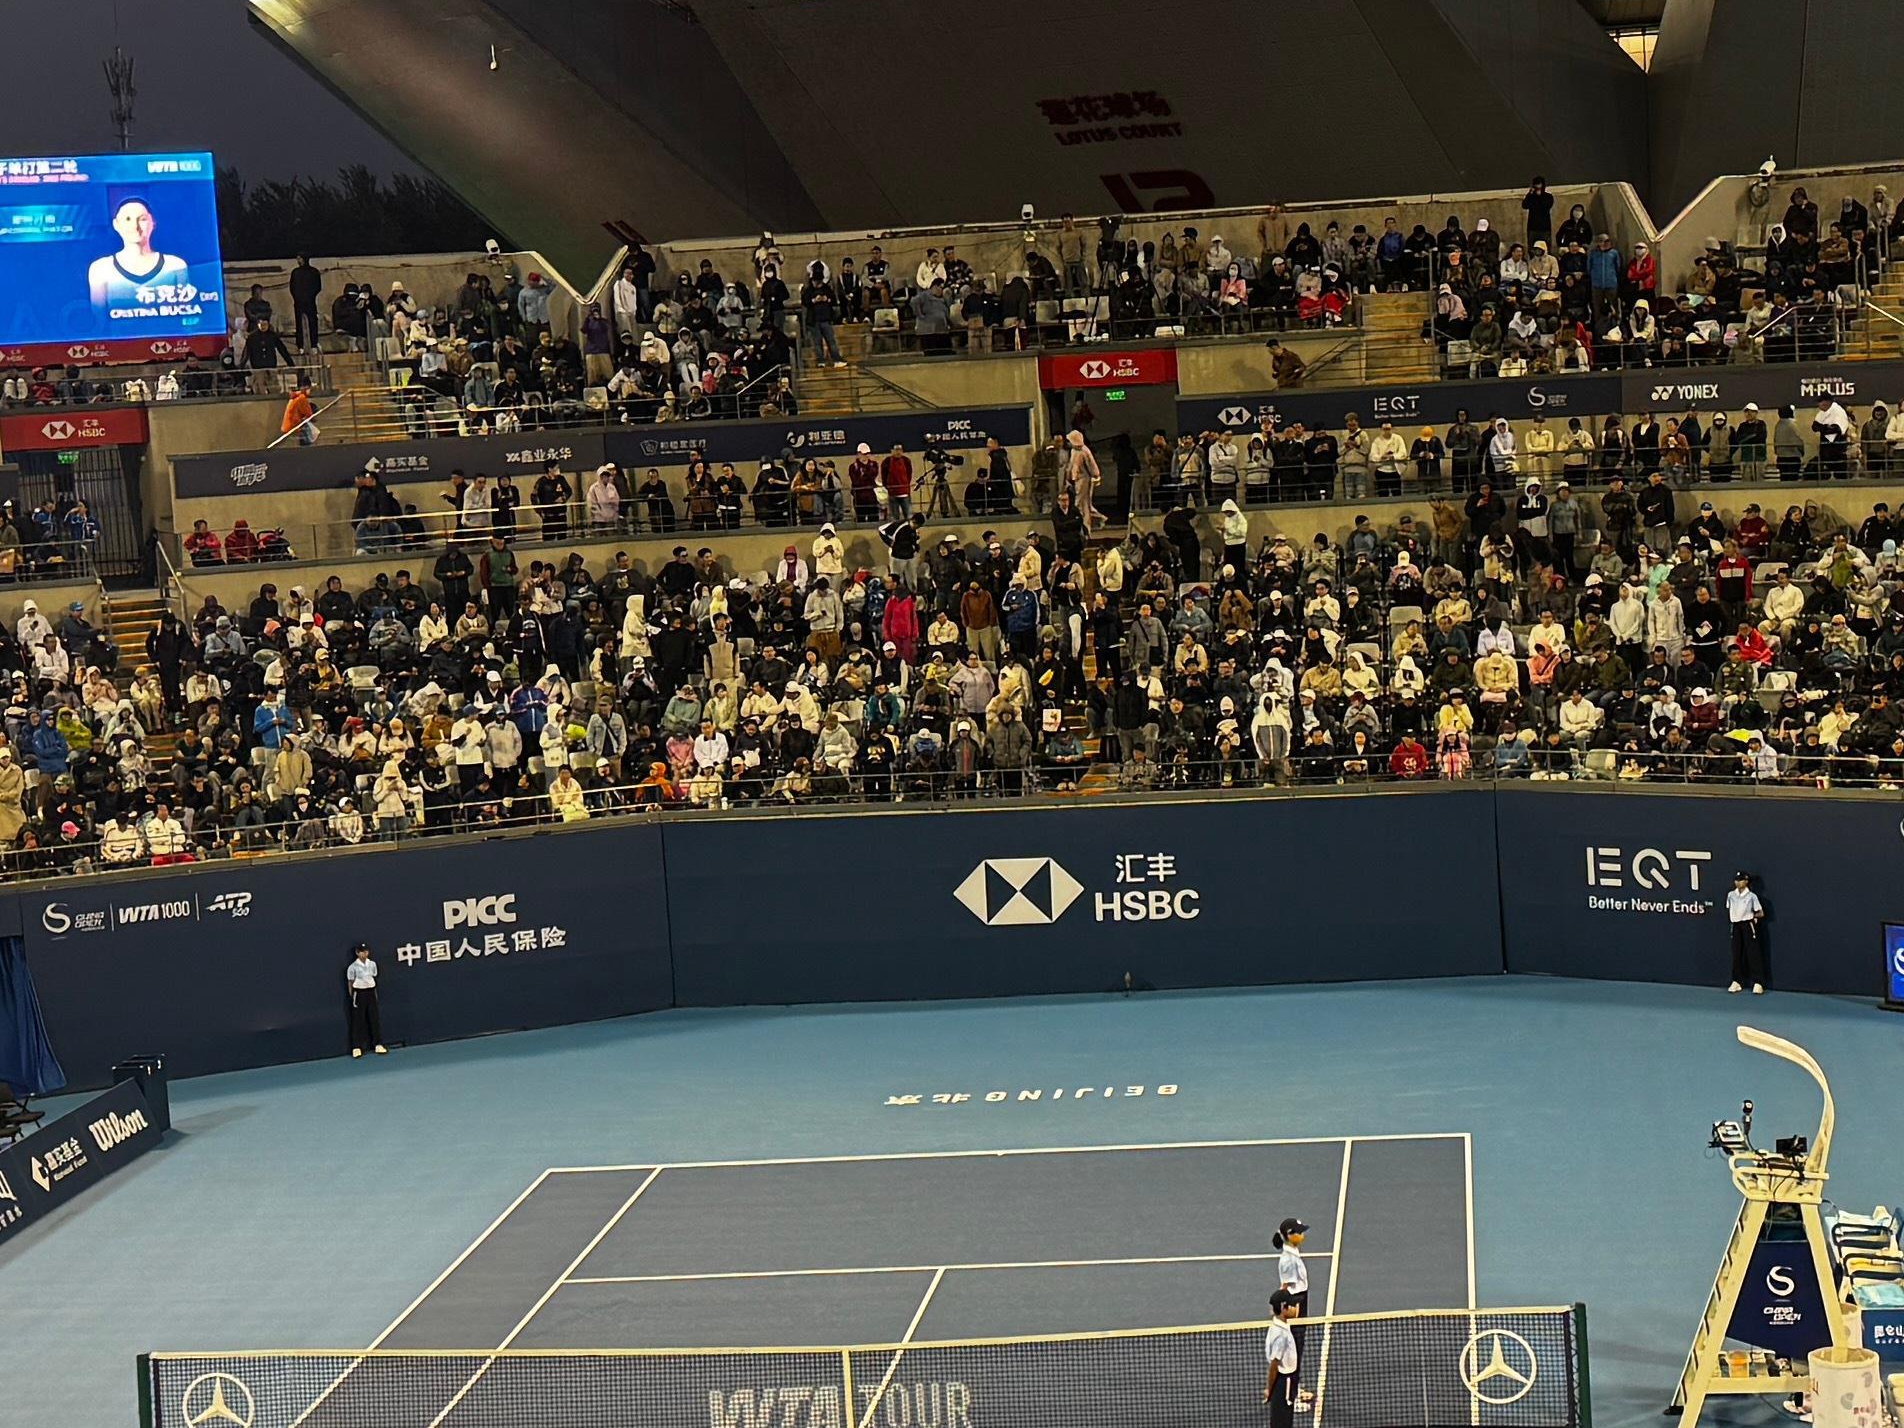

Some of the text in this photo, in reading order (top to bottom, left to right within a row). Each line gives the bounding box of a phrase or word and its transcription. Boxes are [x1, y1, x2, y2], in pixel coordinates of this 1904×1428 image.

[159, 304, 202, 316] BUCSA
[1374, 395, 1420, 411] EQT
[1677, 384, 1719, 399] YONEX
[1115, 852, 1177, 883] 汇丰
[1586, 847, 1712, 891] EQT
[118, 901, 191, 924] WTA 1000
[205, 892, 252, 911] ATP
[442, 894, 517, 930] PICC
[1095, 889, 1200, 922] HSBC
[1588, 895, 1629, 911] Better
[1631, 898, 1670, 913] Never
[397, 926, 567, 967] 中国人民保险
[984, 1083, 1179, 1102] BEIJING
[88, 1108, 148, 1152] Wilson
